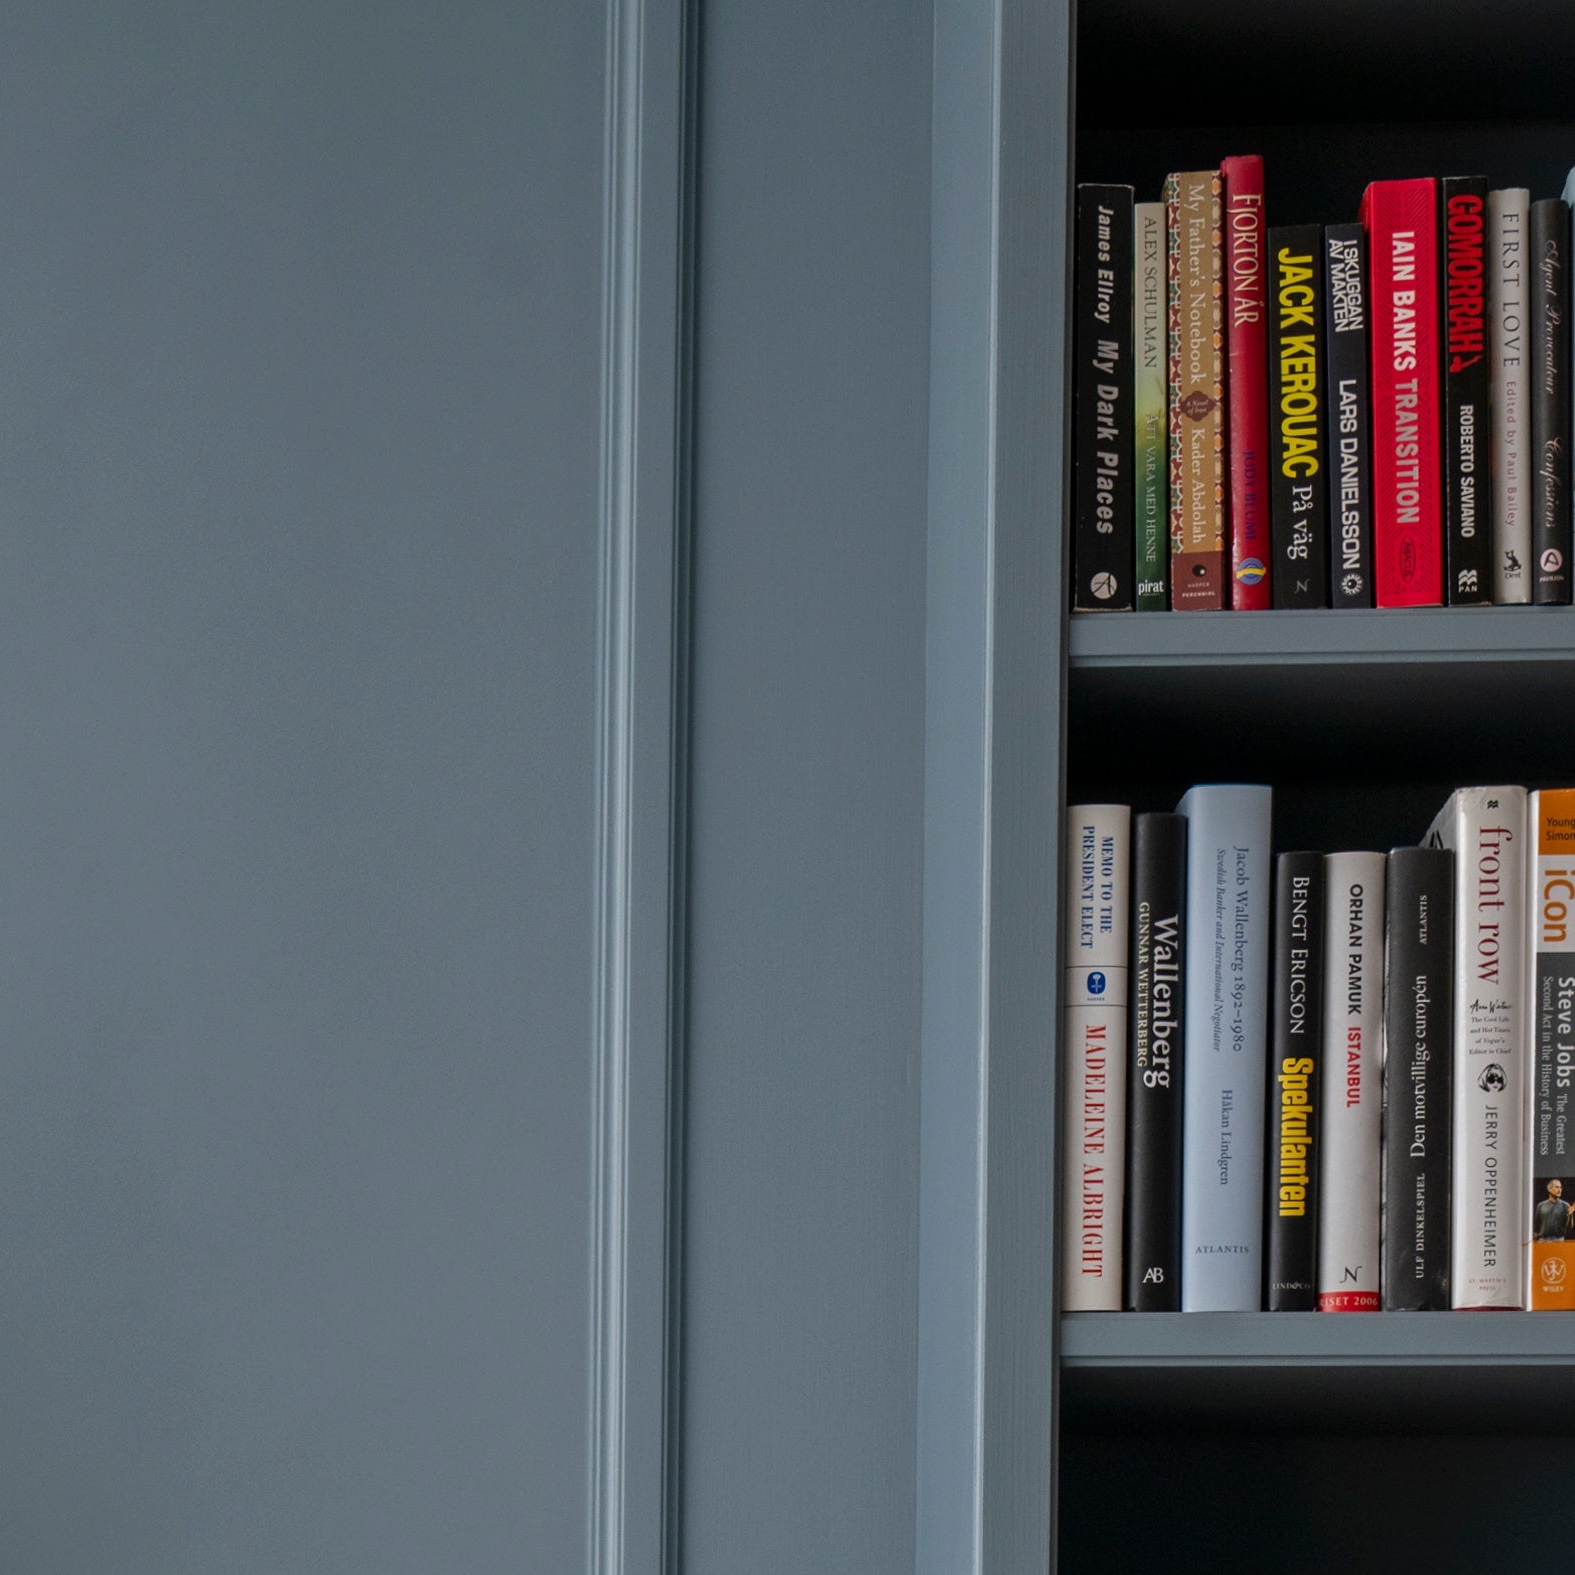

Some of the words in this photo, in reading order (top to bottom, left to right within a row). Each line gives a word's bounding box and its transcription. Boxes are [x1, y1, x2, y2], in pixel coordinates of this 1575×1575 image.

[1184, 184, 1204, 211] My
[1098, 206, 1113, 261] James
[1145, 217, 1157, 261] ALEX
[1229, 195, 1260, 291] FJORTON
[1328, 239, 1343, 261] AV
[1393, 232, 1414, 280] IAIN
[1503, 214, 1519, 286] FIRST
[1094, 269, 1113, 323] Ellroy
[1278, 248, 1314, 328] JACK
[1331, 263, 1348, 332] MAKTEN
[1343, 248, 1363, 330] SKUGGAN
[1451, 198, 1481, 349] GOMORRAH
[1145, 267, 1157, 367] SCHULMAN
[1190, 293, 1206, 384] Notebook
[1233, 299, 1264, 327] ÅR
[1394, 291, 1416, 370] BANKS
[1503, 302, 1519, 366] LOVE
[1093, 340, 1118, 373] My
[1097, 385, 1118, 440] Dark
[1279, 336, 1318, 478] KEROUAC
[1340, 380, 1357, 432] LARS
[1192, 429, 1205, 475] Kader
[1396, 379, 1419, 522] TRANSITION
[1461, 406, 1474, 472] ROBERTO
[1097, 452, 1118, 533] Places
[1193, 480, 1206, 543] Abdolah
[1293, 485, 1313, 512] På
[1341, 438, 1359, 569] DANIELSSON
[1461, 477, 1474, 537] SAVIANO
[1287, 519, 1312, 559] väg
[1140, 580, 1163, 592] pirat
[1459, 584, 1478, 593] PAN
[1082, 827, 1094, 898] PRESIDENT
[1102, 838, 1113, 876] MEMO
[1234, 846, 1249, 885] Jacob
[1479, 827, 1512, 911] front
[1099, 882, 1113, 900] TO
[1101, 907, 1112, 930] THE
[1292, 878, 1309, 940] BENGT
[1350, 884, 1363, 946] ORHAN
[1544, 870, 1575, 942] iCon
[1081, 907, 1093, 946] ELECT
[1139, 902, 1149, 964] GUNNAR
[1231, 891, 1249, 971] Wallenberg
[1479, 925, 1499, 983] row
[1143, 915, 1178, 1088] Wallenberg
[1290, 950, 1308, 1033] ERICSON
[1349, 954, 1362, 1014] PAMUK
[1416, 976, 1430, 1038] europén
[1558, 977, 1575, 1034] Steve
[1137, 969, 1148, 1066] WETTERBERG
[1084, 1026, 1106, 1153] MADELEINE
[1347, 1028, 1361, 1107] ISTANBUL
[1411, 1042, 1430, 1119] motvillige
[1557, 1043, 1575, 1087] Jobs
[1222, 1090, 1233, 1127] Håkan
[1278, 1058, 1310, 1216] Spekulanten
[1486, 1106, 1497, 1149] JERRY
[1218, 1133, 1232, 1184] Lindgren
[1410, 1125, 1425, 1157] Den
[1083, 1164, 1103, 1276] ALBRIGHT
[1416, 1174, 1424, 1251] DINKELSPIEL
[1484, 1158, 1497, 1266] OPPENHEIMER
[1198, 1246, 1250, 1254] ATLANTIS
[1416, 1256, 1424, 1278] ULF
